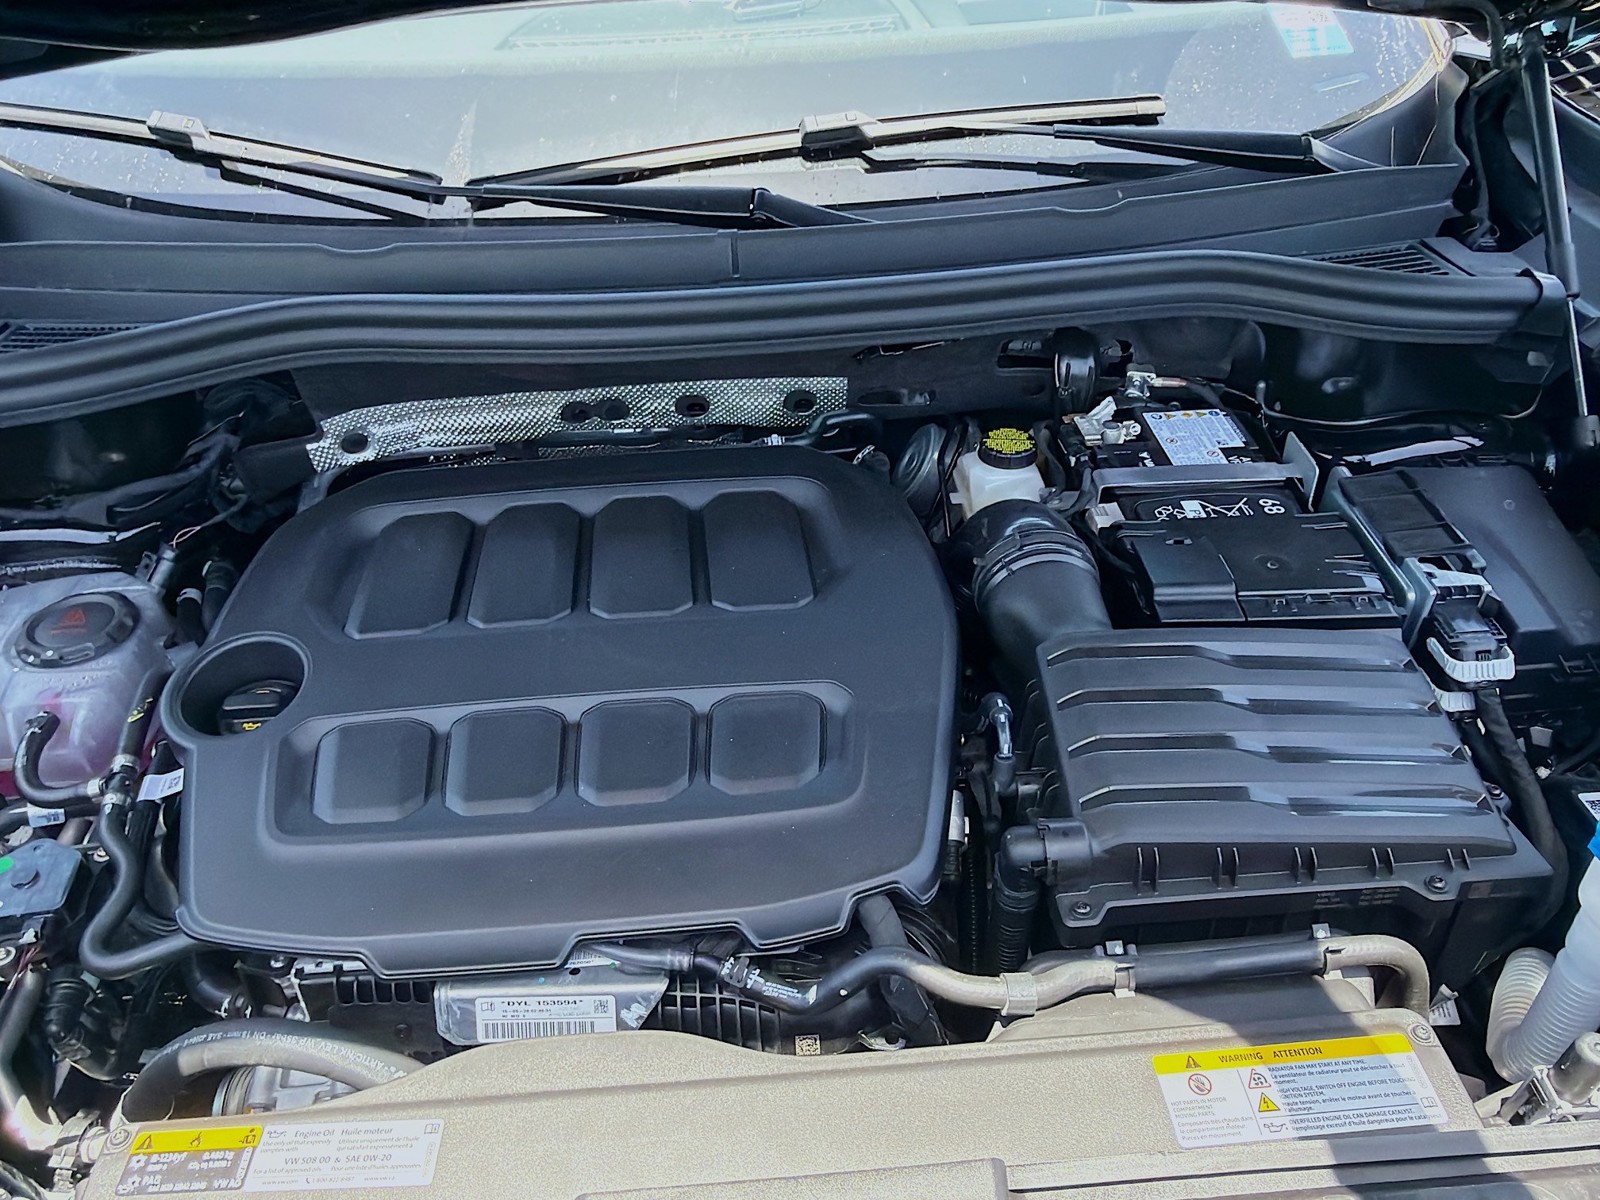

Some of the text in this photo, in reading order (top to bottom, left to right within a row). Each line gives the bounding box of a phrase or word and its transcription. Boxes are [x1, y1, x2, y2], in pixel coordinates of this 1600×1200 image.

[1218, 1046, 1322, 1063] WARNING ATTENTION
[294, 1130, 321, 1138] Engine
[363, 1154, 392, 1162] 0W-20
